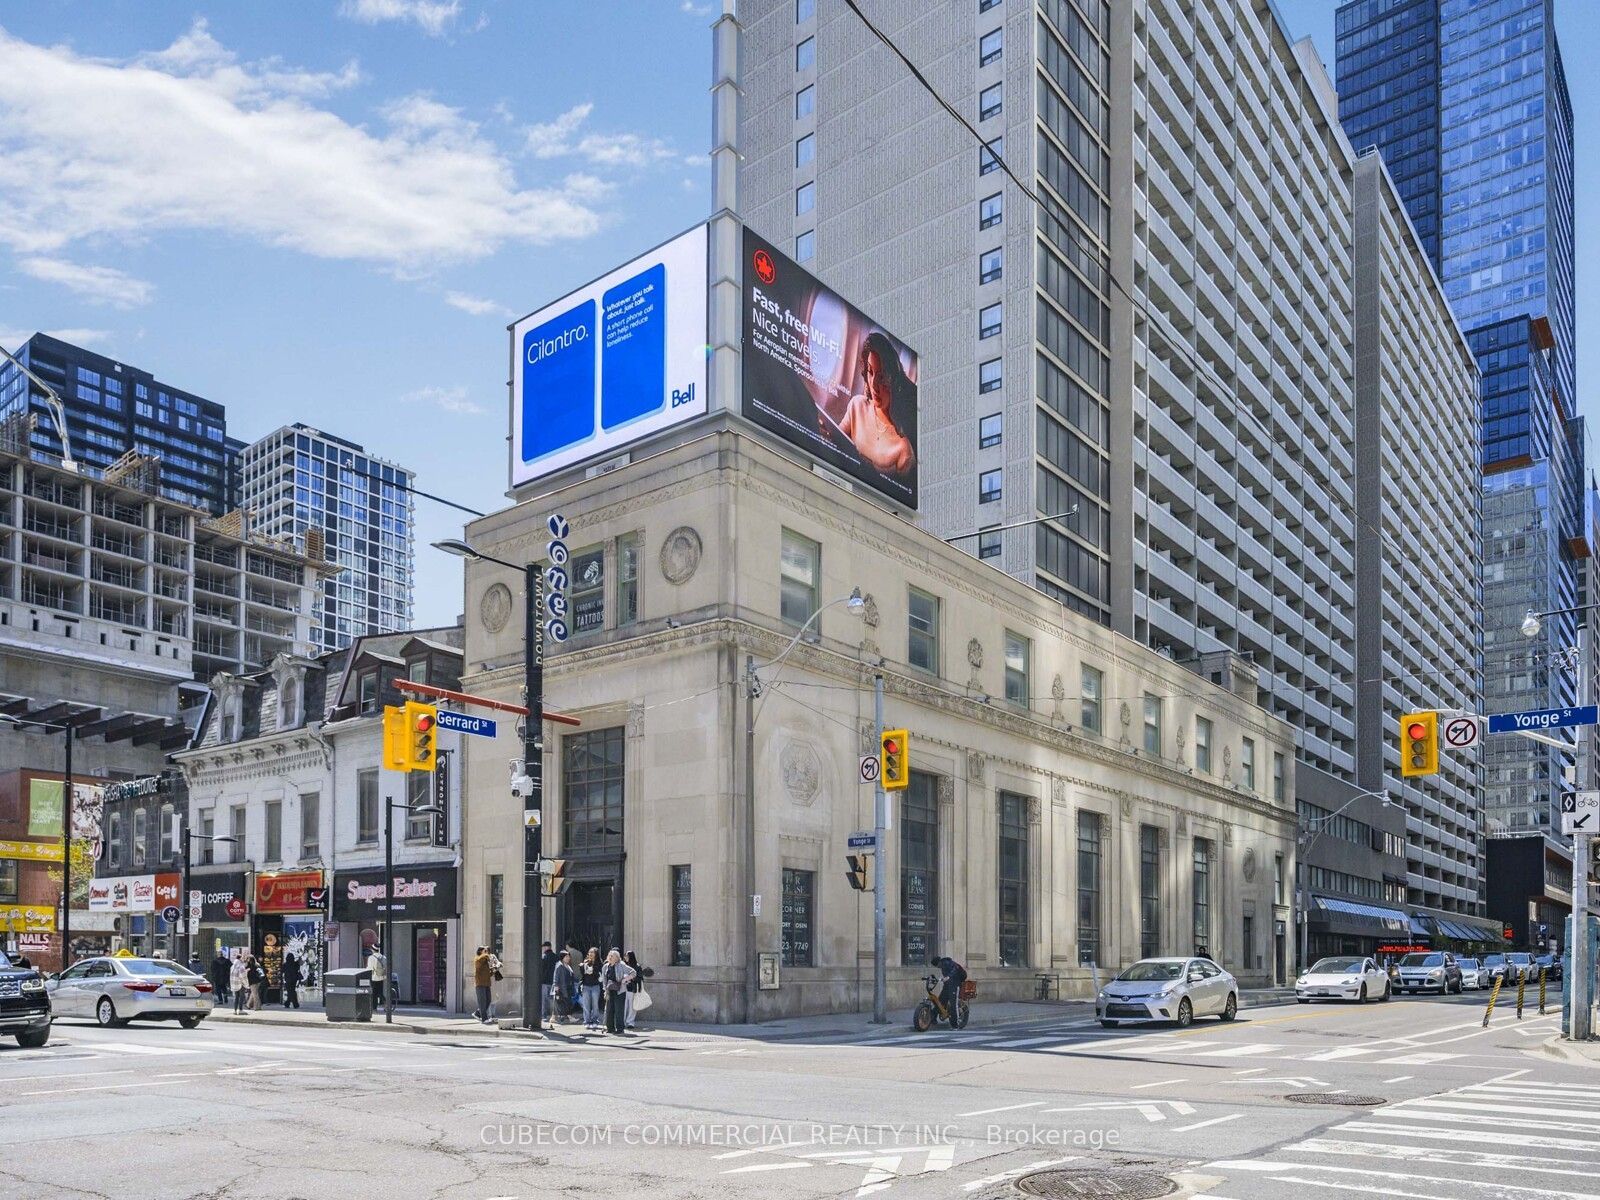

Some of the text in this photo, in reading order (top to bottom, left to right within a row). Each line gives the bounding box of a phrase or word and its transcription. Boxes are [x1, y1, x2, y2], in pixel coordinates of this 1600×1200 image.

[606, 284, 655, 312] Whatever you talk
[623, 302, 635, 314] just
[606, 303, 654, 333] A short phone call
[606, 316, 649, 340] can help reduce
[752, 286, 843, 360] Fast, free Wi-Fi.
[527, 324, 589, 364] Cilantro.
[752, 307, 821, 366] Nice travels.
[752, 328, 763, 340] For
[763, 335, 788, 359] Aeroplan
[752, 339, 770, 355] North
[769, 349, 794, 369] America.
[672, 382, 695, 409] Bell
[547, 514, 570, 643] Yonge
[534, 573, 544, 665] DOWNTOWN
[576, 610, 604, 628] TATTOOS
[437, 711, 480, 731] Gerrard
[1513, 713, 1560, 728] Yonge
[393, 877, 437, 898] Eater
[908, 903, 926, 911] CORNER
[20, 933, 50, 944] NAILS
